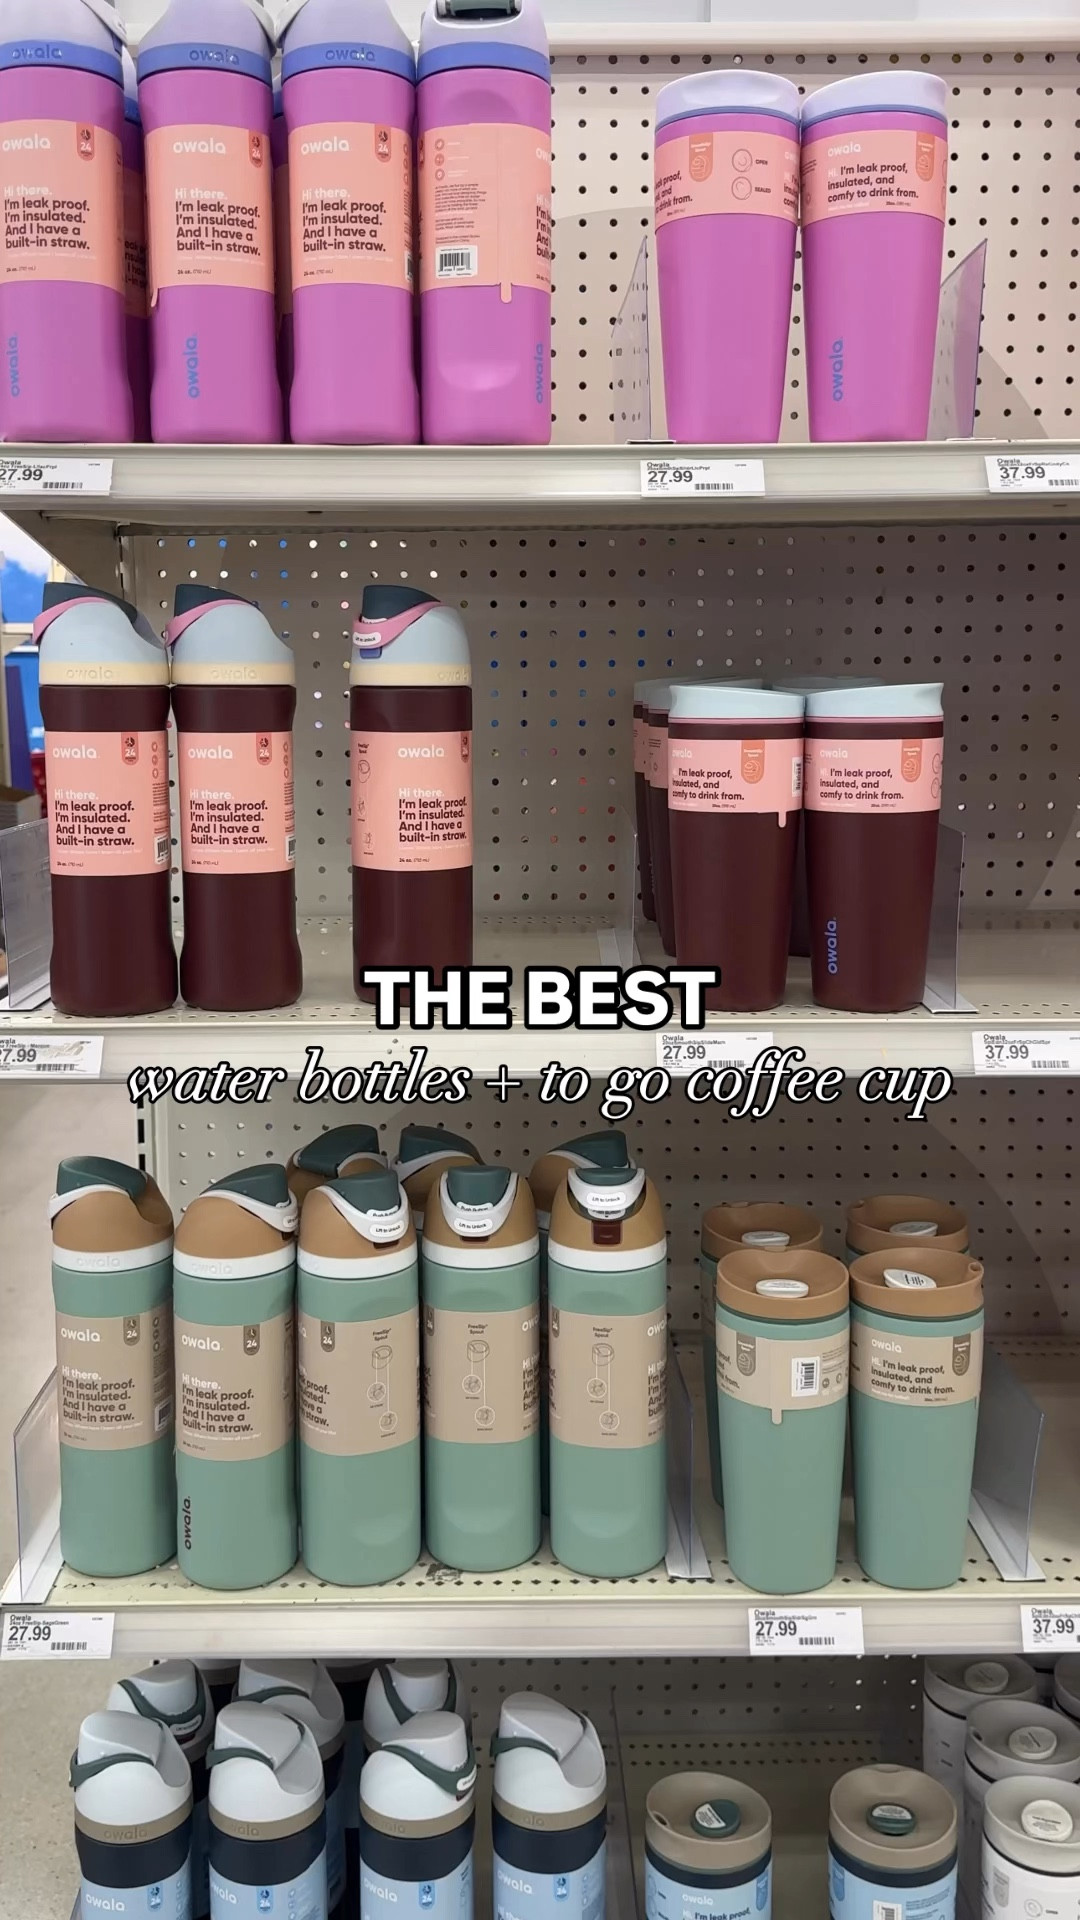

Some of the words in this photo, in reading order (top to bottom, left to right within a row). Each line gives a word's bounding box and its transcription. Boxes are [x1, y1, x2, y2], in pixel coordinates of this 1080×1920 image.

[12, 45, 62, 59] owala
[189, 49, 239, 65] owala
[325, 48, 376, 62] owala
[2, 134, 51, 151] owala
[81, 142, 91, 151] 24
[173, 138, 226, 154] owala
[301, 137, 350, 155] owala
[378, 143, 388, 152] 24
[828, 142, 861, 156] owala
[252, 149, 260, 158] 24
[841, 165, 854, 175] I'm
[857, 164, 877, 174] leak
[881, 164, 907, 175] proof,
[828, 177, 872, 190] insulated,
[876, 176, 894, 184] and
[4, 186, 13, 196] Hi
[16, 186, 52, 196] there.
[302, 189, 312, 201] Hi
[315, 188, 350, 198] there.
[828, 190, 854, 202] comfy
[857, 190, 866, 198] to
[870, 188, 893, 197] drink
[896, 188, 918, 198] from.
[5, 200, 19, 211] I'm
[22, 200, 49, 210] leak
[52, 200, 90, 212] proof.
[302, 202, 317, 213] I'm
[320, 201, 347, 212] leak
[351, 201, 386, 215] proof.
[5, 213, 20, 223] I'm
[22, 211, 86, 224] insulated.
[303, 215, 317, 225] I'm
[321, 213, 382, 225] insulated.
[6, 237, 47, 249] built-in
[50, 239, 90, 250] straw.
[303, 240, 342, 252] built-in
[348, 240, 385, 252] straw.
[7, 336, 20, 398] owala
[184, 336, 199, 398] owala
[534, 343, 543, 403] owala
[829, 339, 843, 401] owala
[648, 471, 693, 484] 27.99
[1000, 466, 1045, 479] 37.99
[53, 746, 97, 759] owala
[125, 749, 136, 757] 24
[188, 746, 233, 759] owala
[259, 748, 269, 757] 24
[398, 744, 444, 758] owala
[820, 749, 847, 758] owala
[830, 768, 841, 777] I'm
[845, 768, 863, 777] leak
[865, 768, 893, 779] proof,
[820, 779, 858, 789] insulated,
[861, 780, 879, 788] and
[54, 789, 63, 800] Hi
[66, 790, 98, 800] there.
[399, 789, 410, 798] Hi
[413, 789, 444, 797] there.
[820, 790, 842, 801] comfy
[845, 791, 852, 799] to
[855, 790, 878, 799] drink
[881, 790, 904, 799] from.
[55, 800, 68, 811] I'm
[71, 800, 95, 811] leak
[99, 800, 134, 814] proof.
[399, 799, 415, 808] I'm
[419, 799, 441, 808] leak
[444, 797, 466, 810] proof.
[56, 812, 68, 823] I'm
[72, 812, 130, 823] insulated.
[399, 811, 416, 819] I'm
[419, 809, 464, 820] insulated.
[56, 835, 94, 846] built-in
[97, 836, 134, 846] straw.
[399, 832, 439, 842] built-in
[443, 831, 466, 841] straw.
[824, 919, 837, 974] owala
[0, 1049, 36, 1062] 7.99
[663, 1046, 705, 1059] 27.99
[985, 1046, 1028, 1059] 37.99
[61, 1328, 101, 1342] owala
[127, 1330, 137, 1339] 24
[323, 1336, 332, 1345] 24
[182, 1335, 221, 1351] owala
[246, 1340, 257, 1349] 24
[872, 1338, 902, 1353] owala
[883, 1359, 896, 1370] I'm
[898, 1362, 916, 1373] leak
[920, 1366, 944, 1376] proof,
[182, 1374, 189, 1384] Hi
[192, 1376, 221, 1389] there.
[872, 1368, 912, 1384] insulated,
[915, 1374, 932, 1384] and
[182, 1384, 194, 1397] I'm
[196, 1387, 218, 1399] leak
[221, 1389, 253, 1401] proof.
[871, 1378, 896, 1393] comfy
[898, 1383, 907, 1392] to
[910, 1384, 932, 1394] drink
[934, 1386, 954, 1394] from.
[183, 1396, 194, 1408] I'm
[196, 1398, 250, 1411] insulated.
[183, 1419, 216, 1431] built-in
[218, 1422, 253, 1433] straw.
[182, 1499, 191, 1549] owala
[755, 1621, 797, 1636] 27.99
[1033, 1619, 1074, 1633] 37.99
[9, 1626, 51, 1640] 27.99
[104, 1829, 147, 1840] owala
[498, 1871, 532, 1894] owala
[364, 1880, 397, 1902] owala
[86, 1893, 125, 1911] owala
[683, 1894, 713, 1905] owala
